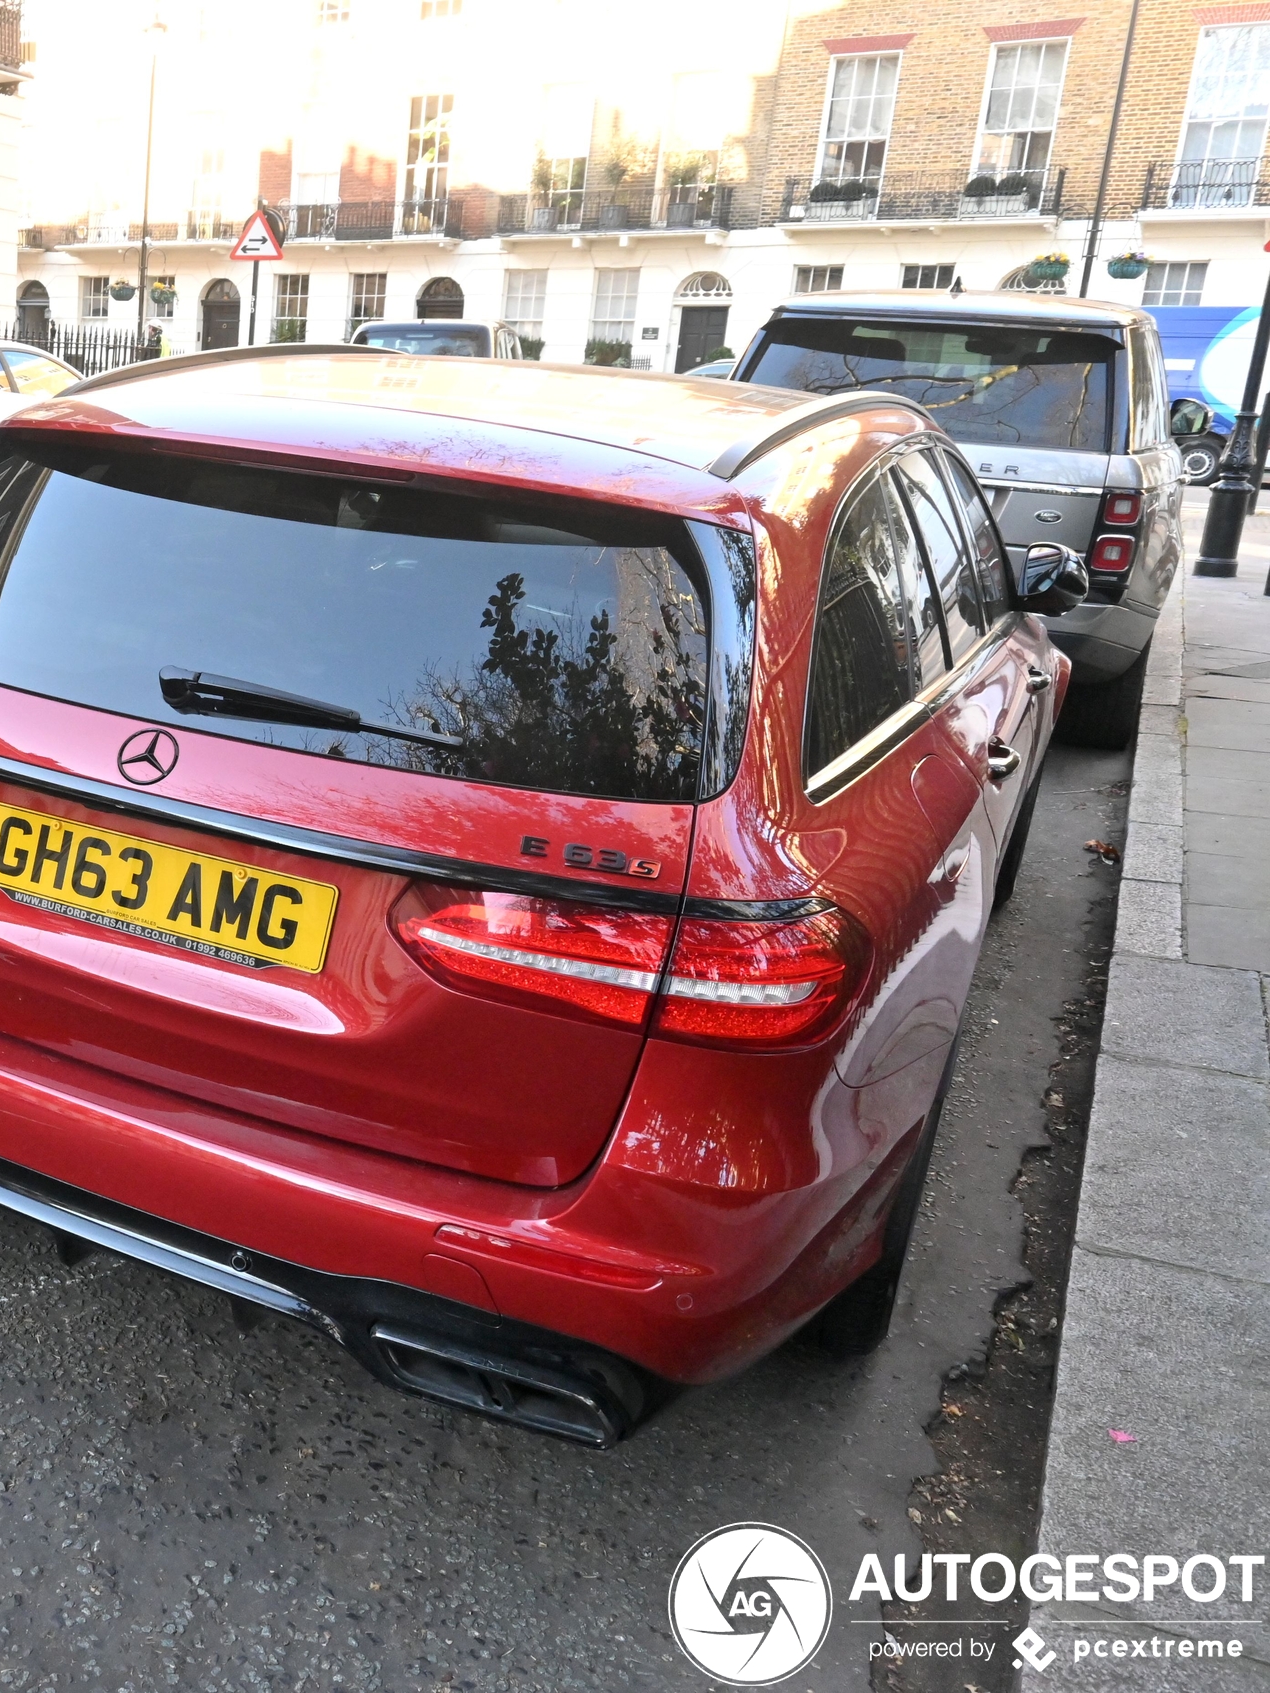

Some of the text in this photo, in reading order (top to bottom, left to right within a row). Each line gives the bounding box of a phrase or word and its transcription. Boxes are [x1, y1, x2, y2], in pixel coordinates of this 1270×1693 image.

[520, 835, 550, 857] E
[14, 891, 256, 966] WWW.BURFORD-CARSALES.CO.UK 01992 469636
[106, 908, 130, 920] BURFORD
[129, 915, 140, 923] CAR
[141, 918, 157, 927] SALES
[166, 861, 303, 950] AMG
